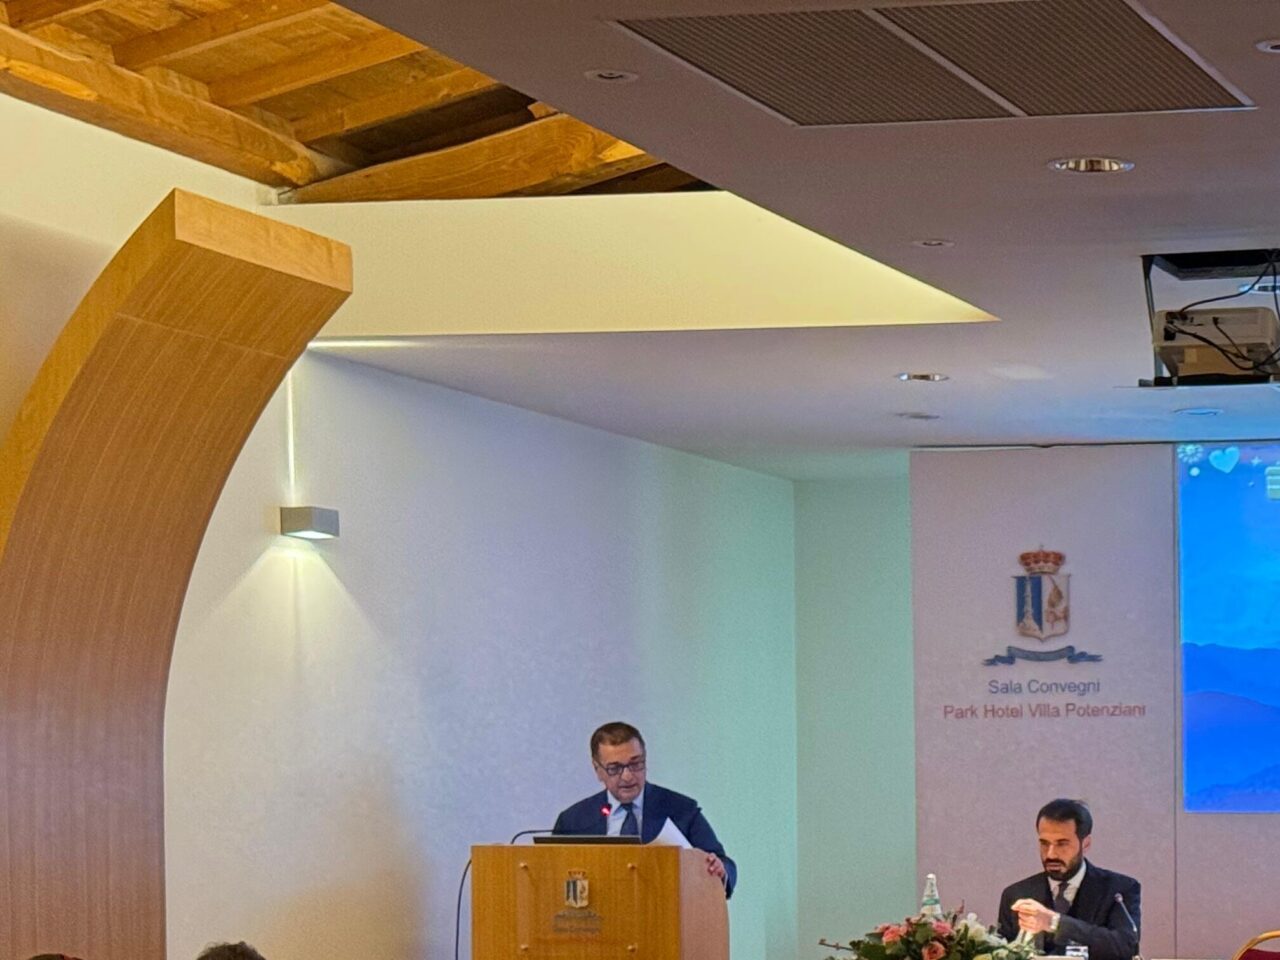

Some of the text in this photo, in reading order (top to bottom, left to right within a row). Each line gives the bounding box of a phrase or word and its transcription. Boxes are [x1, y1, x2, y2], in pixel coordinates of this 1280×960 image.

[988, 679, 1100, 696] Sala Convegni
[943, 701, 1146, 719] Park Hotel Villa Potenziani
